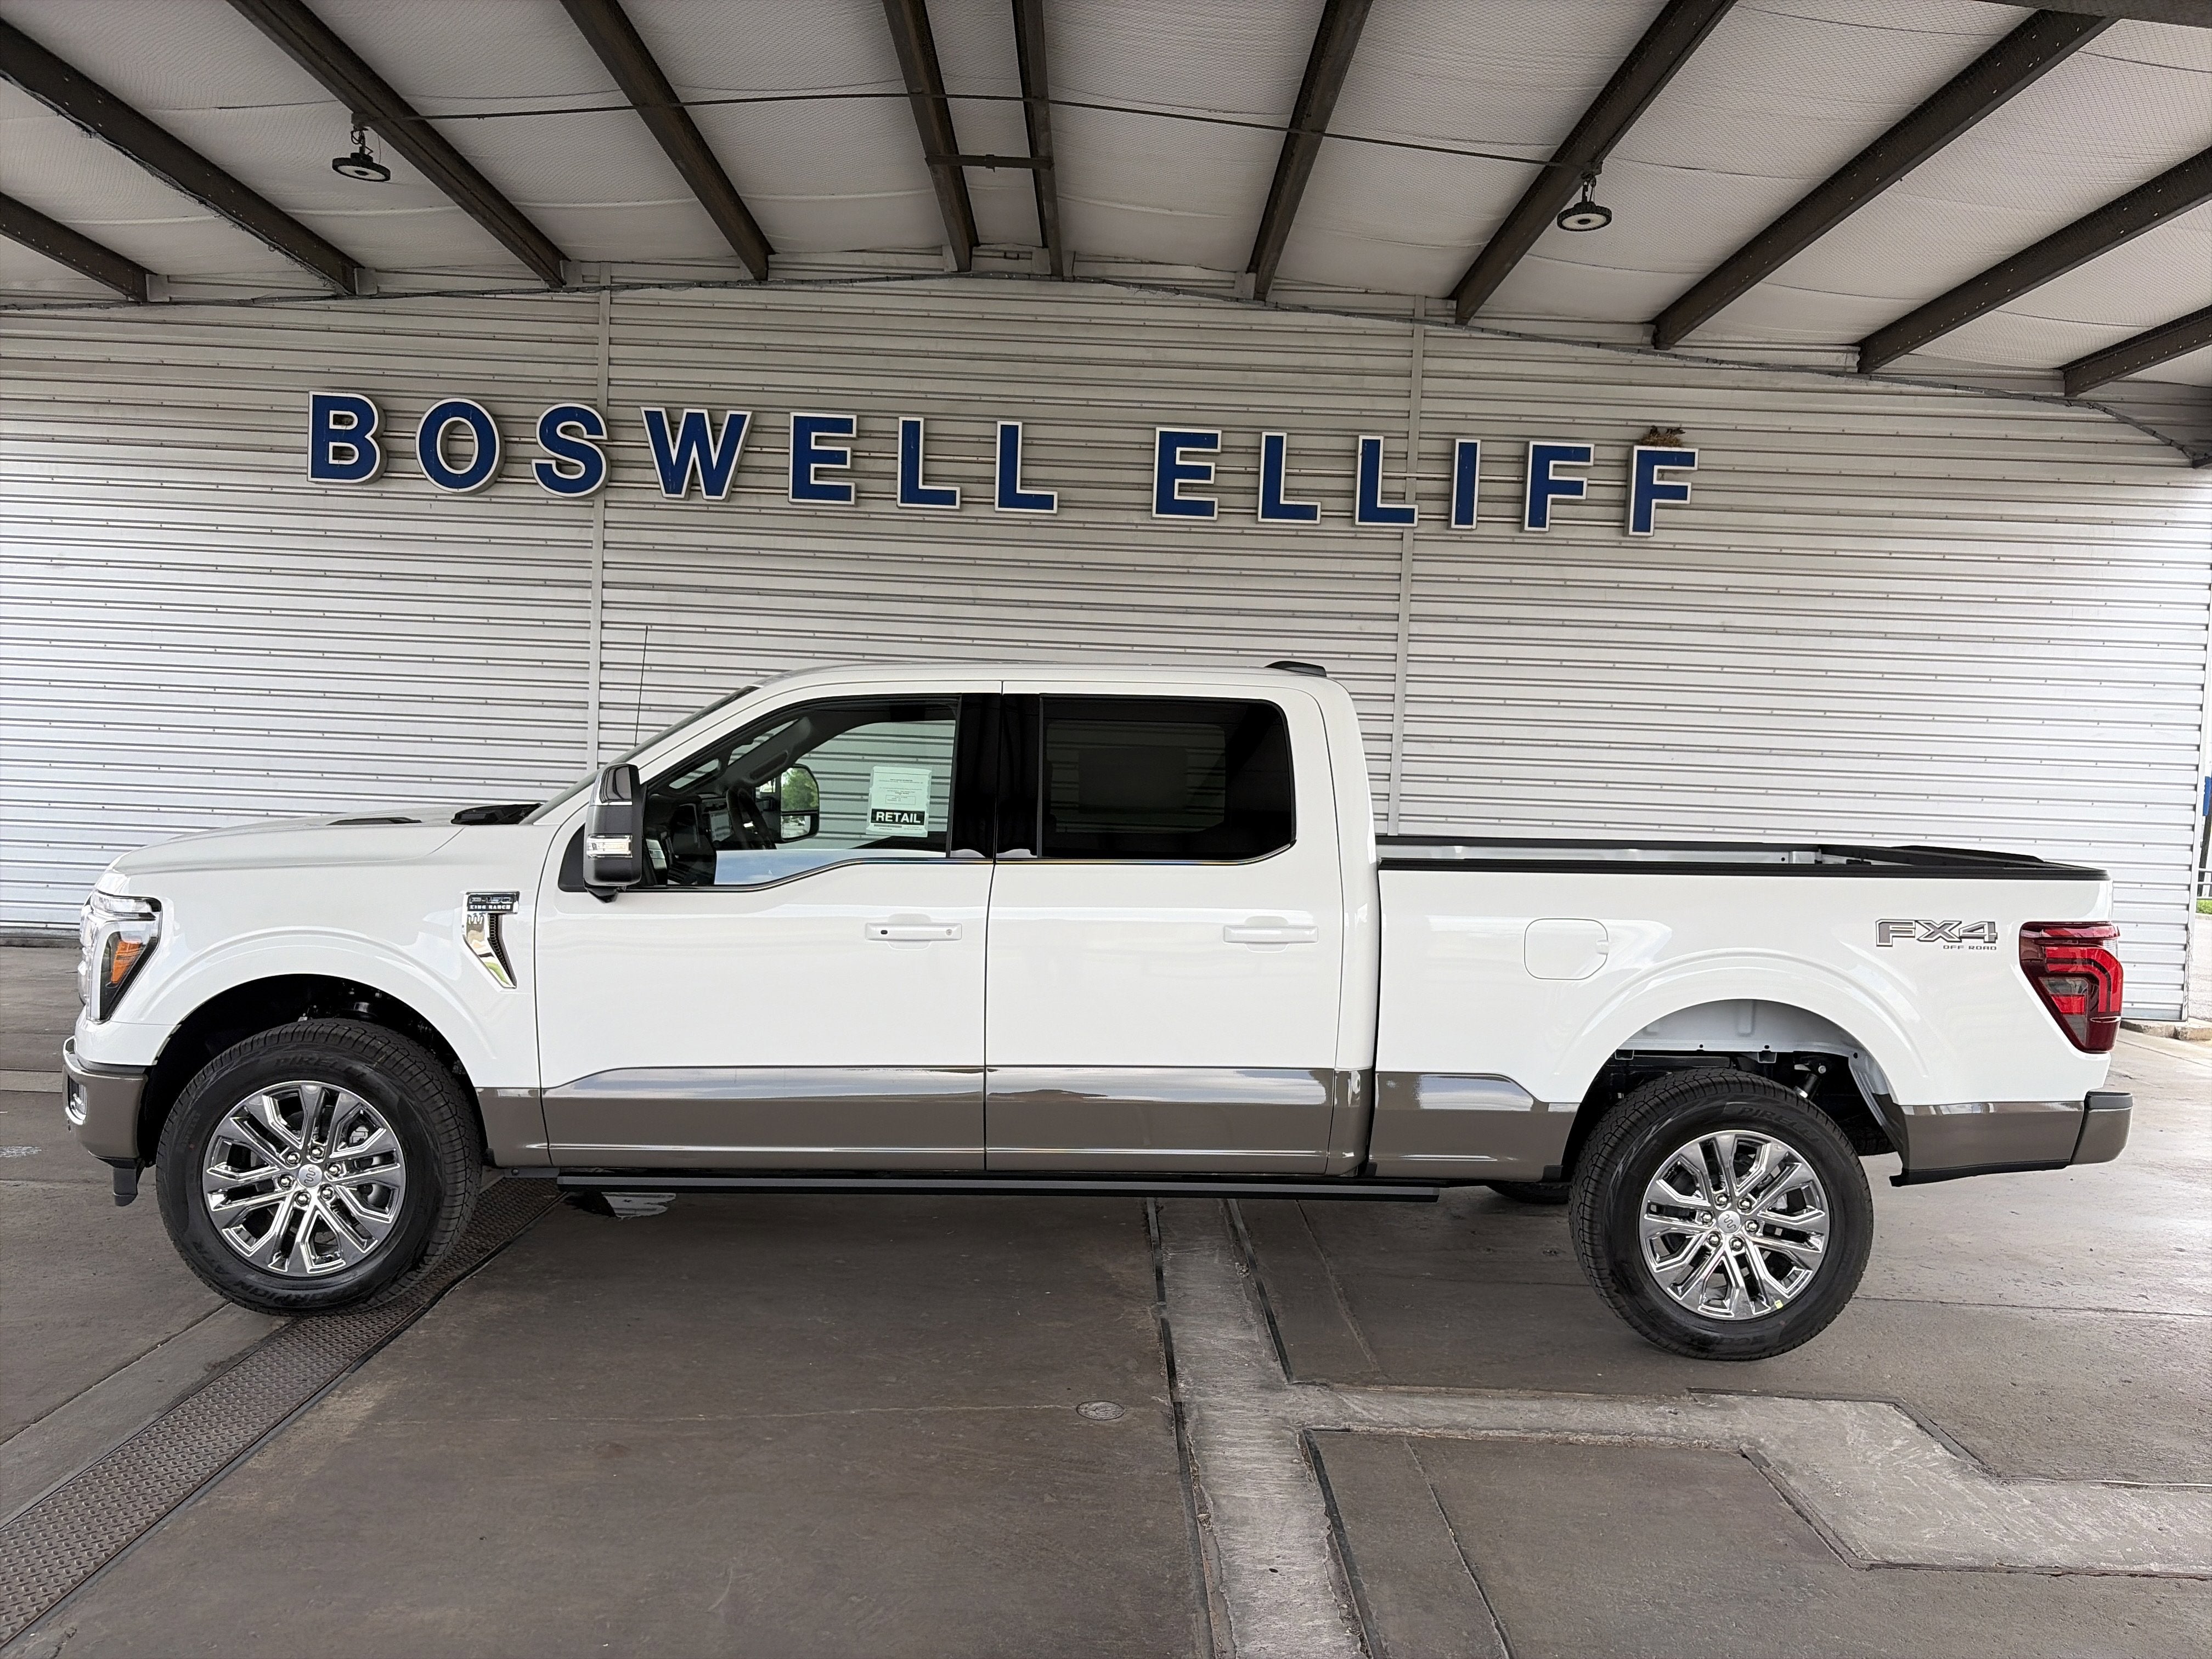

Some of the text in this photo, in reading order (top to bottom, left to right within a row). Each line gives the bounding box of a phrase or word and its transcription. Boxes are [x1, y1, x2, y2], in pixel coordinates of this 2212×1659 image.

[307, 391, 1699, 536] BOSWELL ELLIFF
[876, 811, 921, 823] RETAIL
[1876, 919, 1997, 947] FX4
